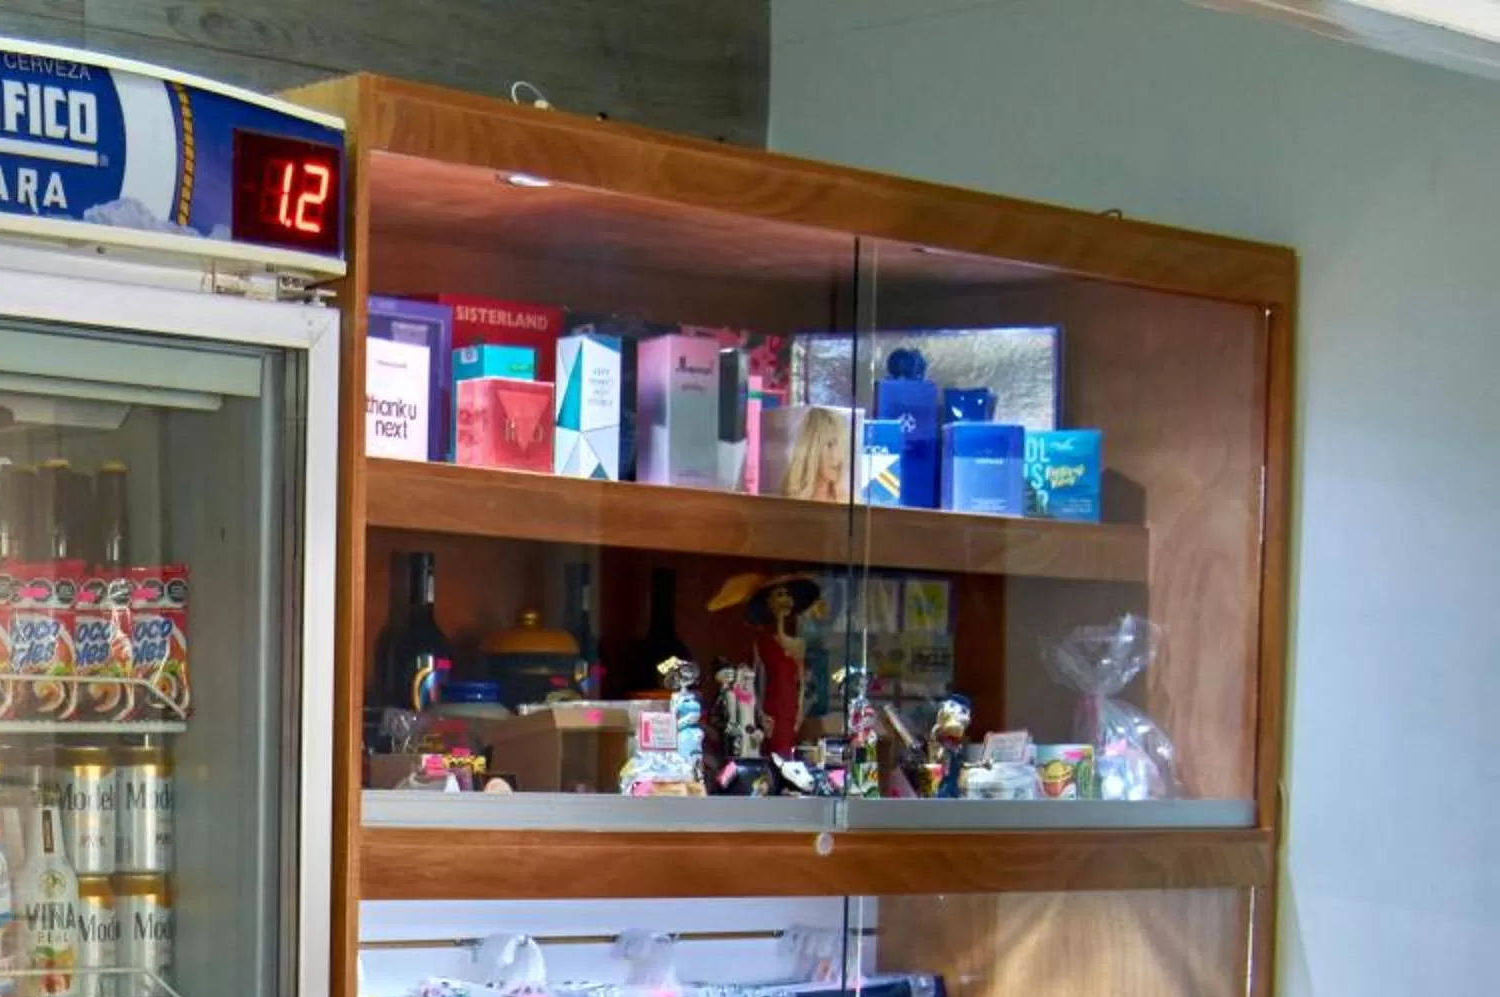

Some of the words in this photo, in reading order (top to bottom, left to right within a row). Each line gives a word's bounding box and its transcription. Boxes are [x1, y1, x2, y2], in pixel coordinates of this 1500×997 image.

[3, 50, 92, 82] CERVEZA
[455, 304, 549, 333] SISTERLAND
[374, 419, 409, 441] next
[133, 617, 173, 644] oco
